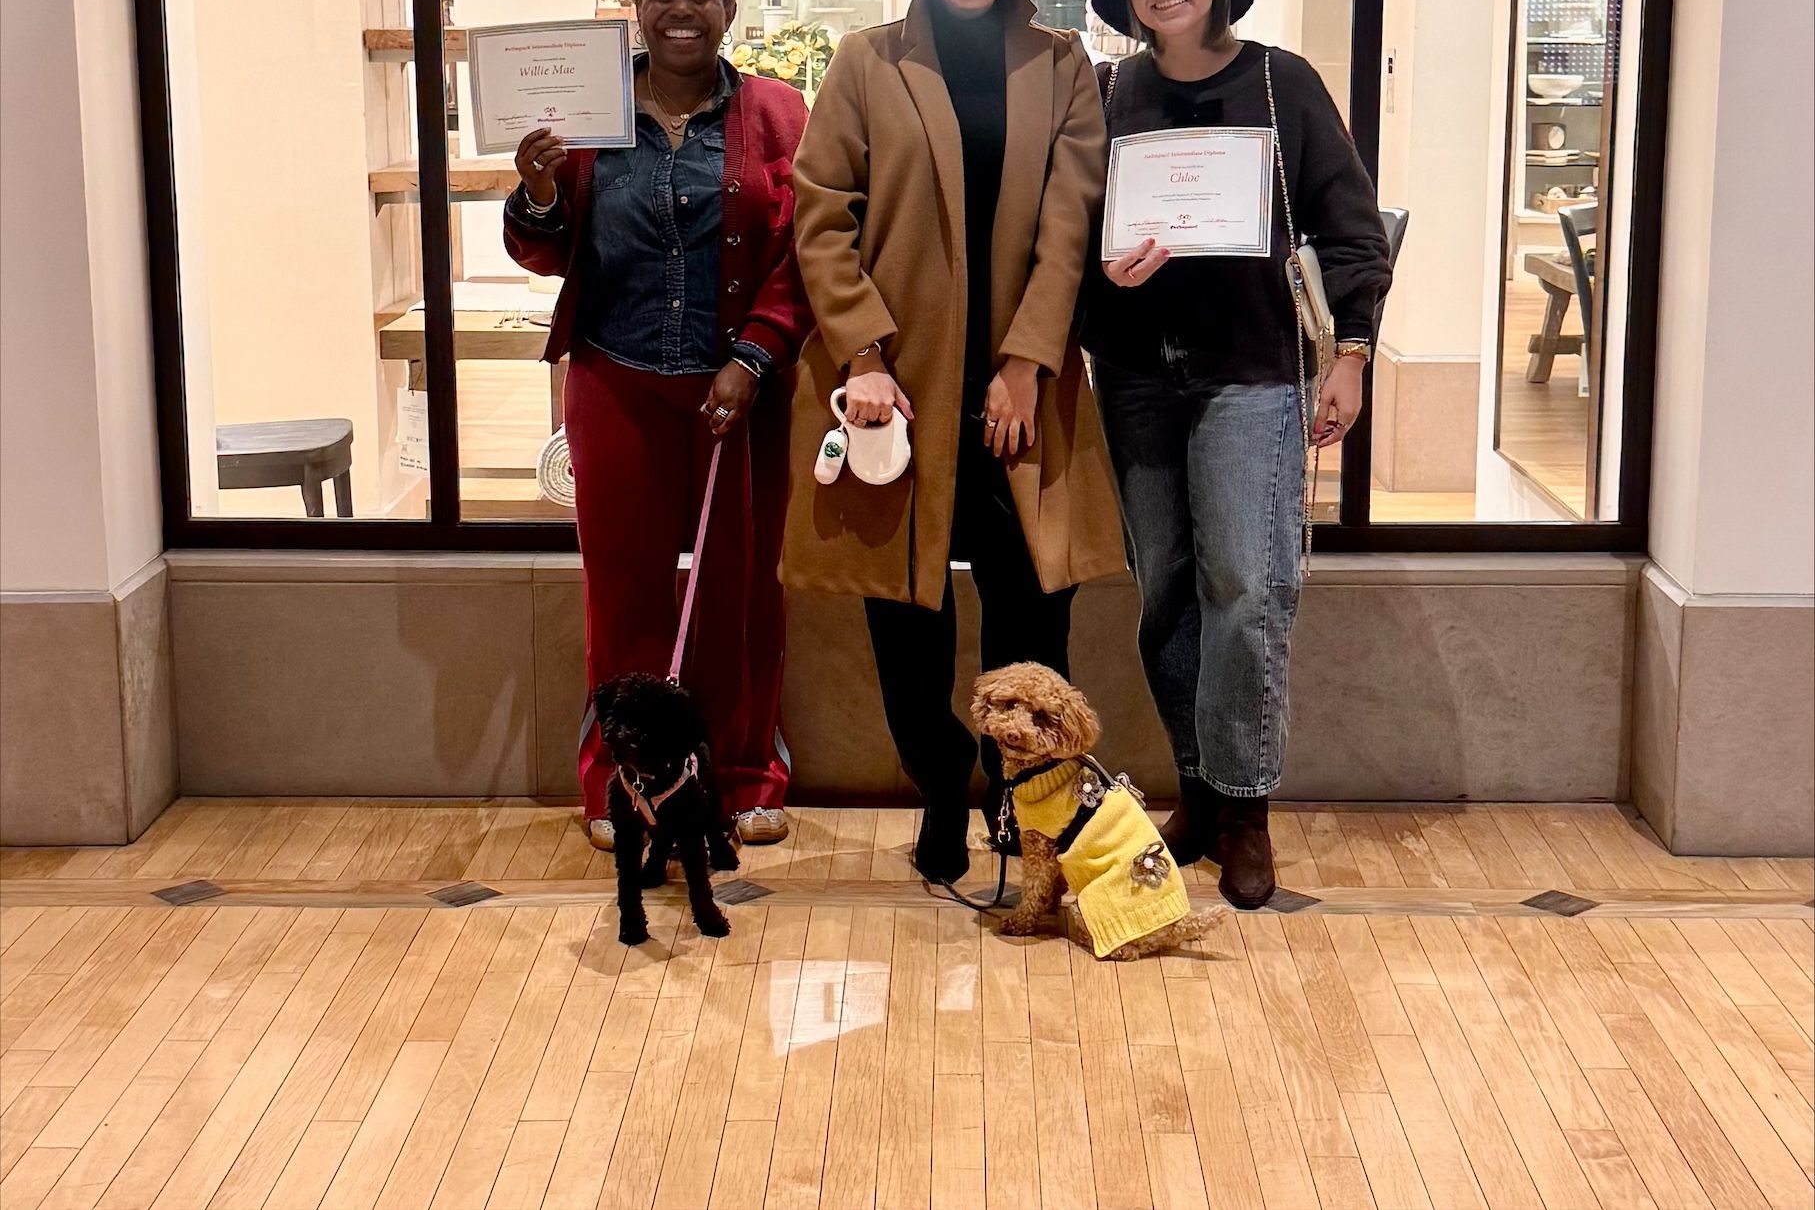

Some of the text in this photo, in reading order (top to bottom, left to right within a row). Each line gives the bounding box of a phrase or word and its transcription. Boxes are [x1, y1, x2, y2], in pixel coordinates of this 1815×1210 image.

[520, 64, 575, 77] Willie Mae
[1170, 171, 1200, 183] Chloe
